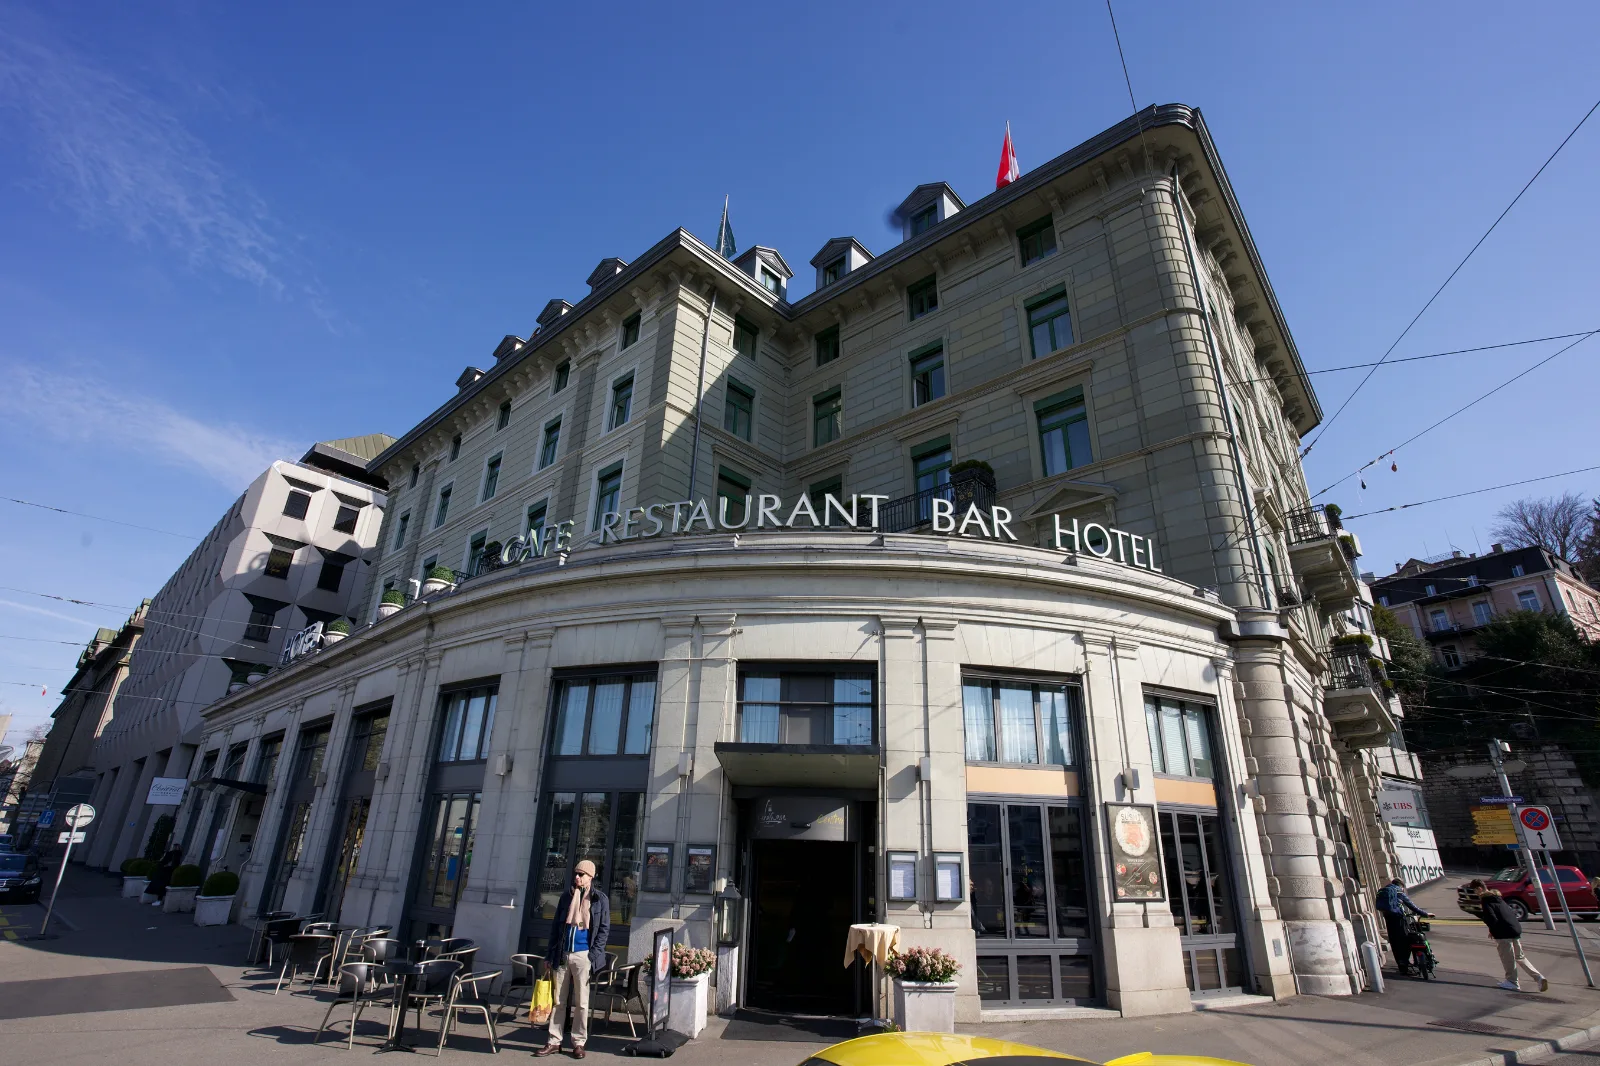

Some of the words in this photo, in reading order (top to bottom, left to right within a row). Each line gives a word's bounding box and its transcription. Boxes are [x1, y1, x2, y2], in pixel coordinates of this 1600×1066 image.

[500, 519, 575, 565] CAFE
[599, 493, 890, 545] RESTAURANT
[932, 497, 1019, 542] BAR
[1053, 513, 1163, 573] HOTEL
[1393, 802, 1413, 810] UBS
